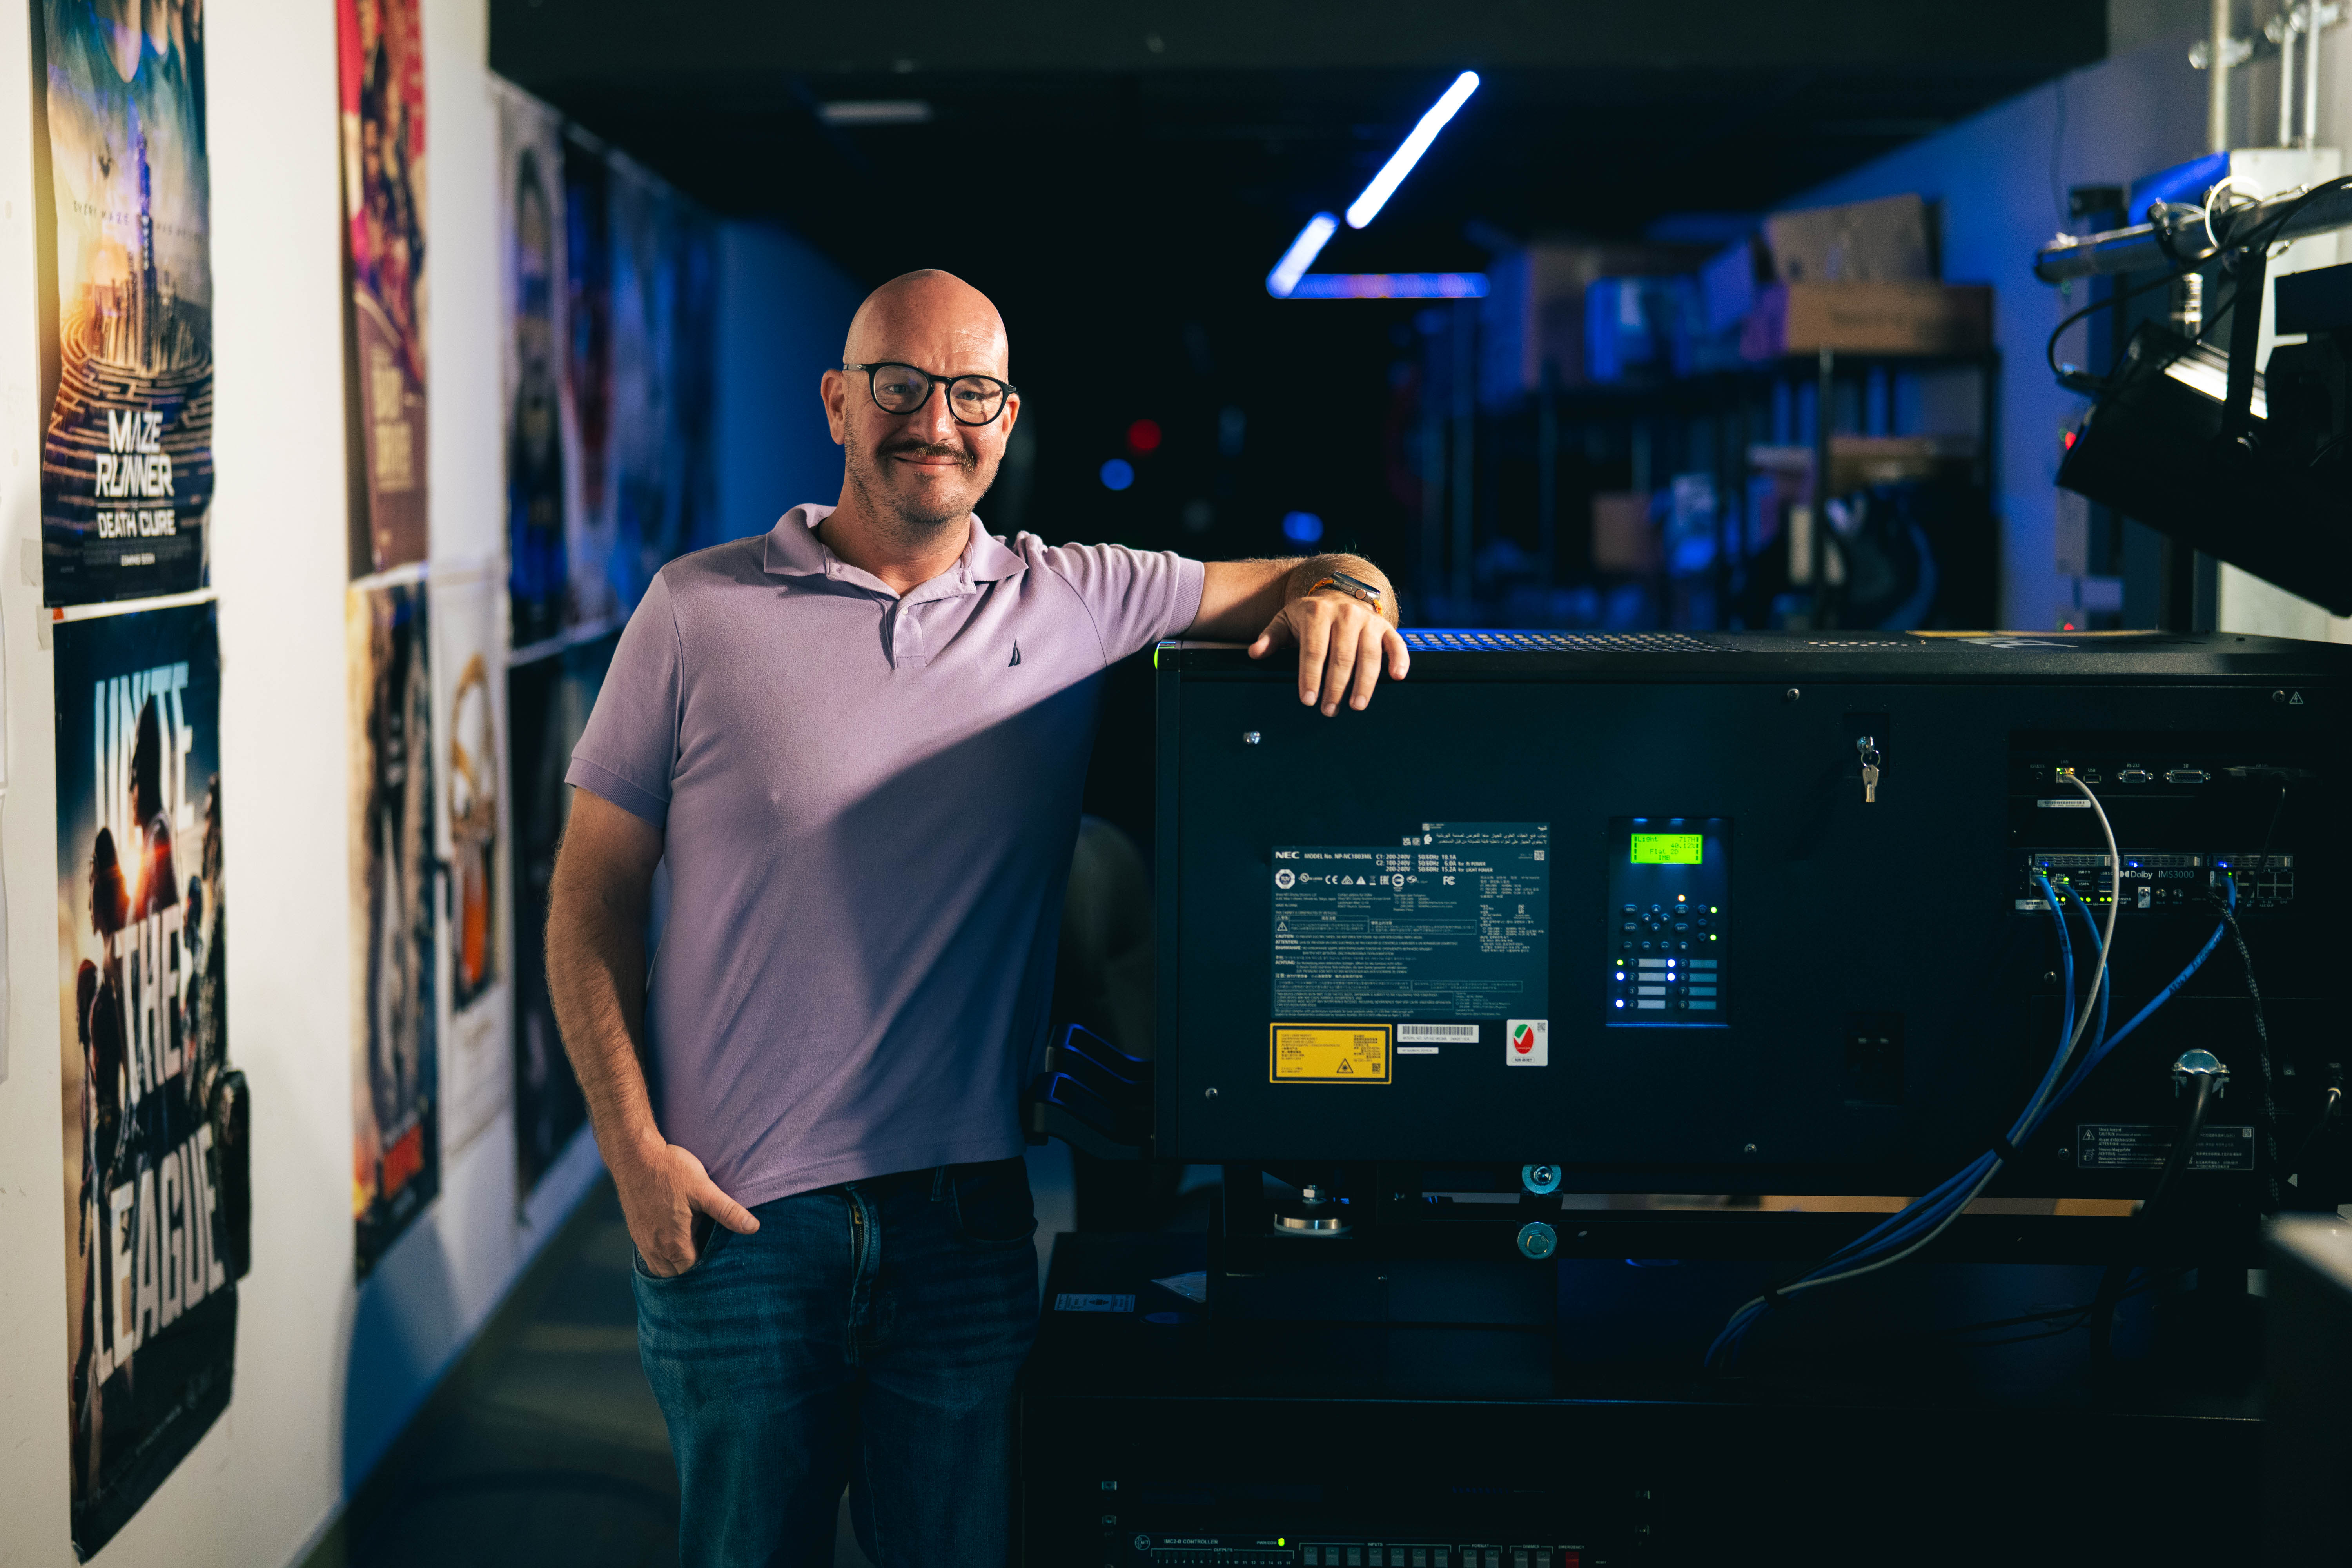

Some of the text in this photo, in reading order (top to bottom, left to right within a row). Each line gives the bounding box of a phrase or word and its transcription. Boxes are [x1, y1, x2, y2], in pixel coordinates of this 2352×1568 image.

[107, 409, 163, 454] MAZE
[95, 453, 175, 497] RUNNER
[96, 508, 176, 539] DEATH CURE
[95, 661, 194, 851] UNTE
[2131, 871, 2153, 880] Dolby
[114, 903, 183, 1106] THE
[91, 1122, 227, 1387] LEAGUE
